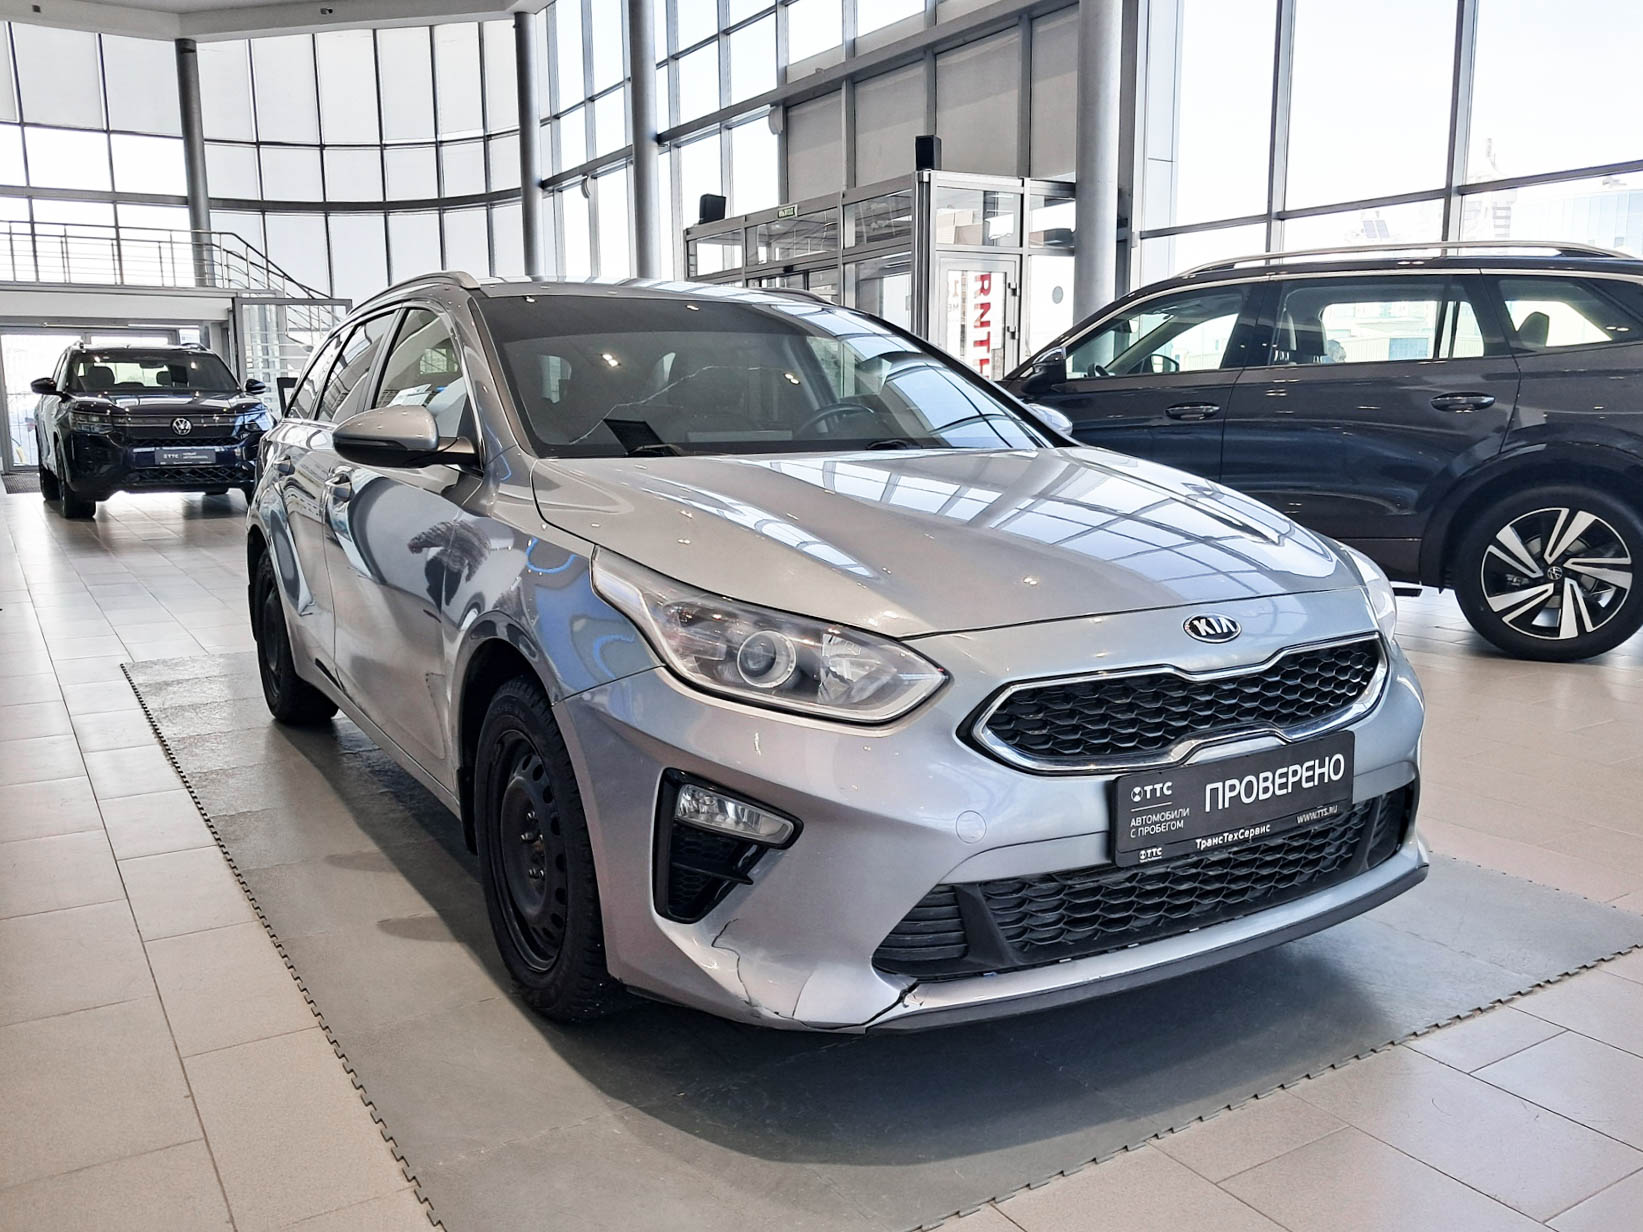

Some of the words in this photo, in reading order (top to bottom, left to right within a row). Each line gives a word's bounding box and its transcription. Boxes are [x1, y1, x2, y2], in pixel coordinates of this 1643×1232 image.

[1192, 617, 1236, 636] KIA
[1204, 753, 1345, 812] ПРОВЕРЕНО
[1130, 807, 1190, 828] АВТОМОБИЛИ
[1130, 828, 1137, 838] С
[1137, 819, 1184, 837] ПРОБЕГОМ
[1195, 823, 1271, 851] ТрансТехСервис
